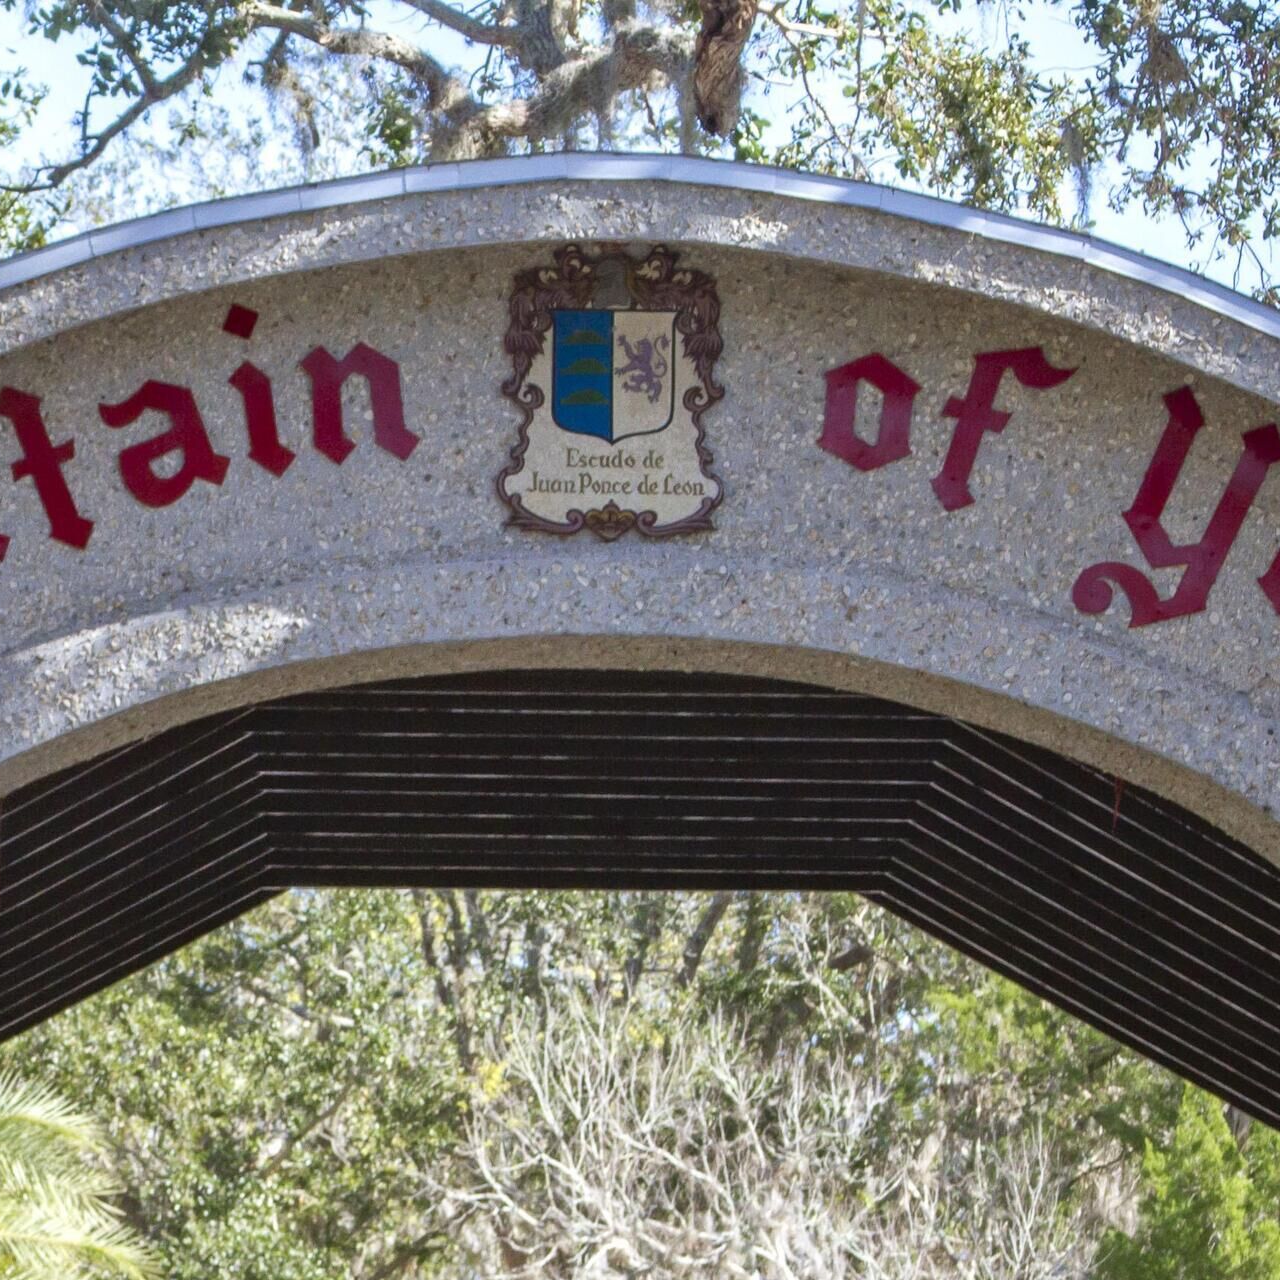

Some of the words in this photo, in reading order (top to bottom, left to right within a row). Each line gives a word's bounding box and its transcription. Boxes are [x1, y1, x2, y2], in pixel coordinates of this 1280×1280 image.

[817, 347, 1077, 512] of
[565, 447, 636, 469] Escudo
[642, 450, 665, 468] de
[526, 471, 576, 494] Juan
[578, 473, 632, 495] Ponce
[637, 475, 658, 496] de
